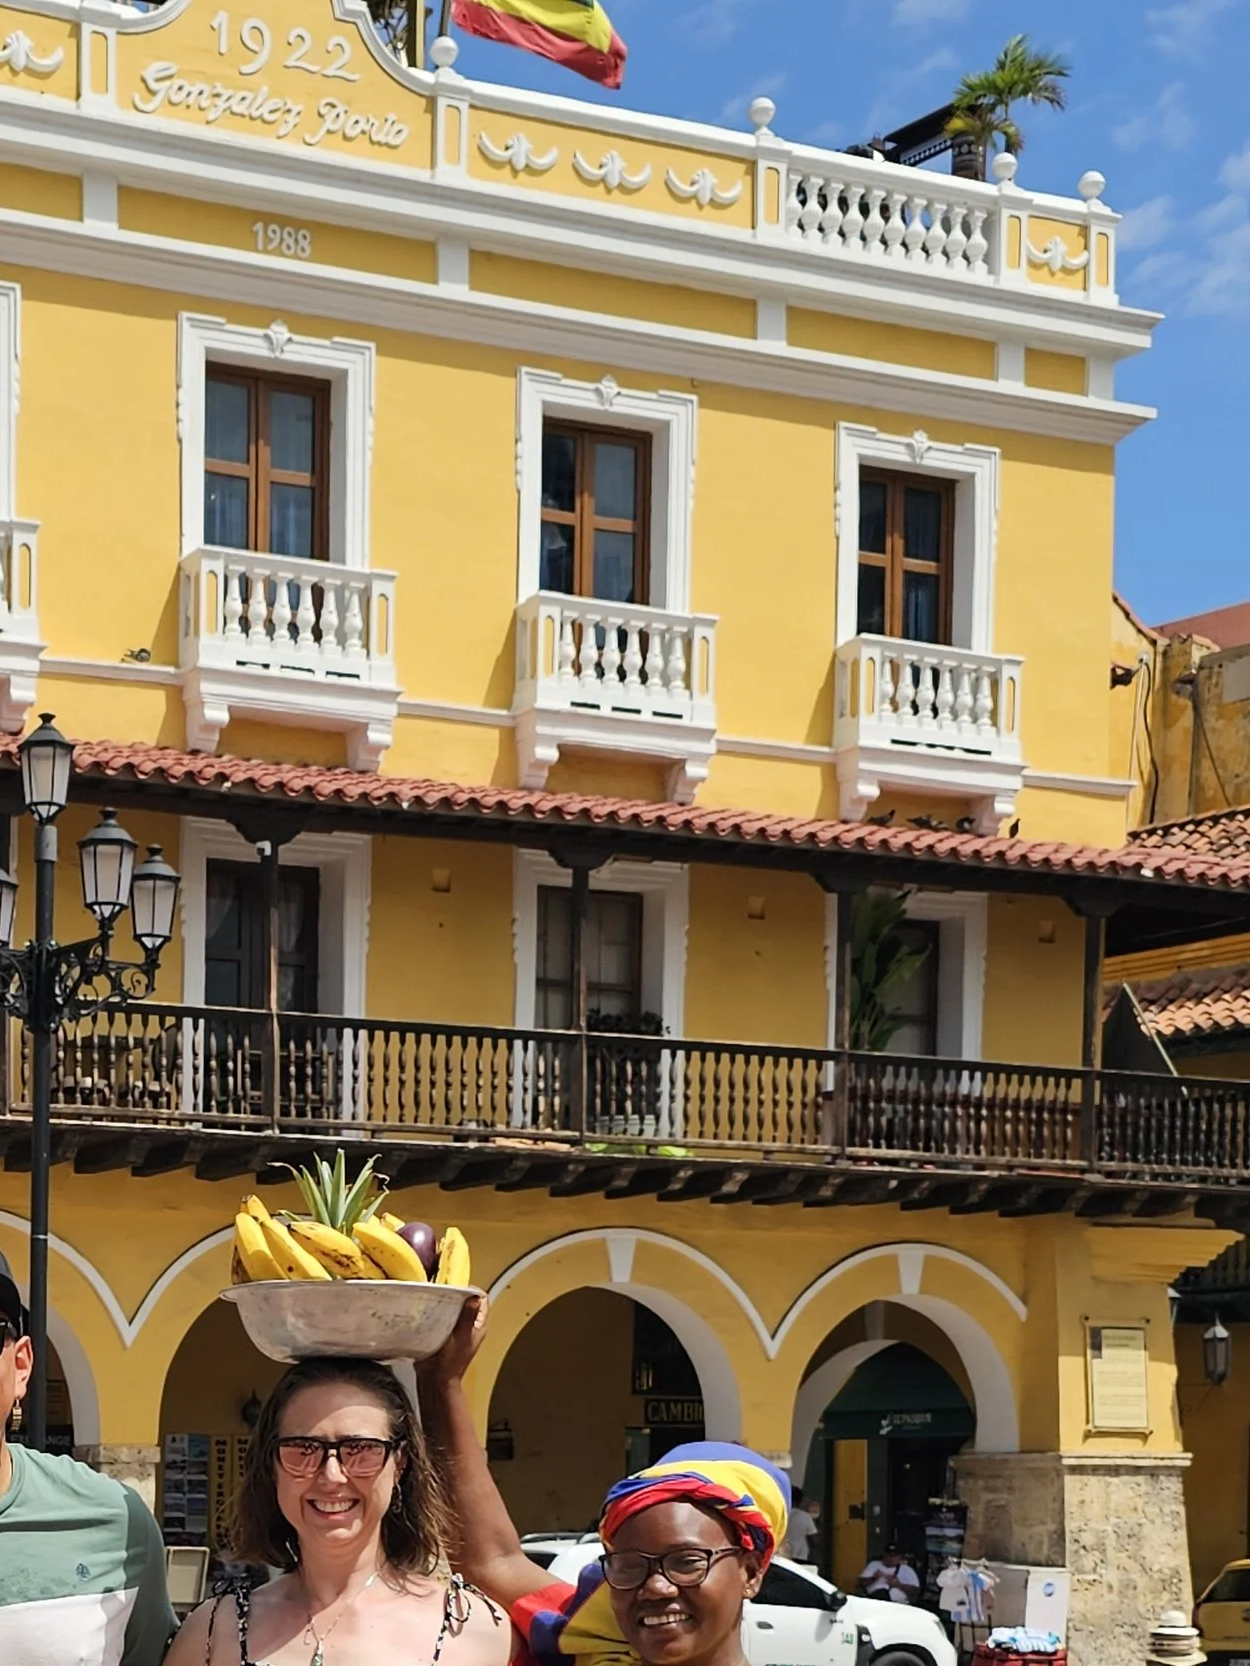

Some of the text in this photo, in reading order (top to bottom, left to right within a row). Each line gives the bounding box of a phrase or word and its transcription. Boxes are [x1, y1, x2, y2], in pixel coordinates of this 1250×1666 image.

[210, 10, 361, 82] 1922
[132, 61, 301, 138] Gonzalez
[252, 222, 311, 259] 1988
